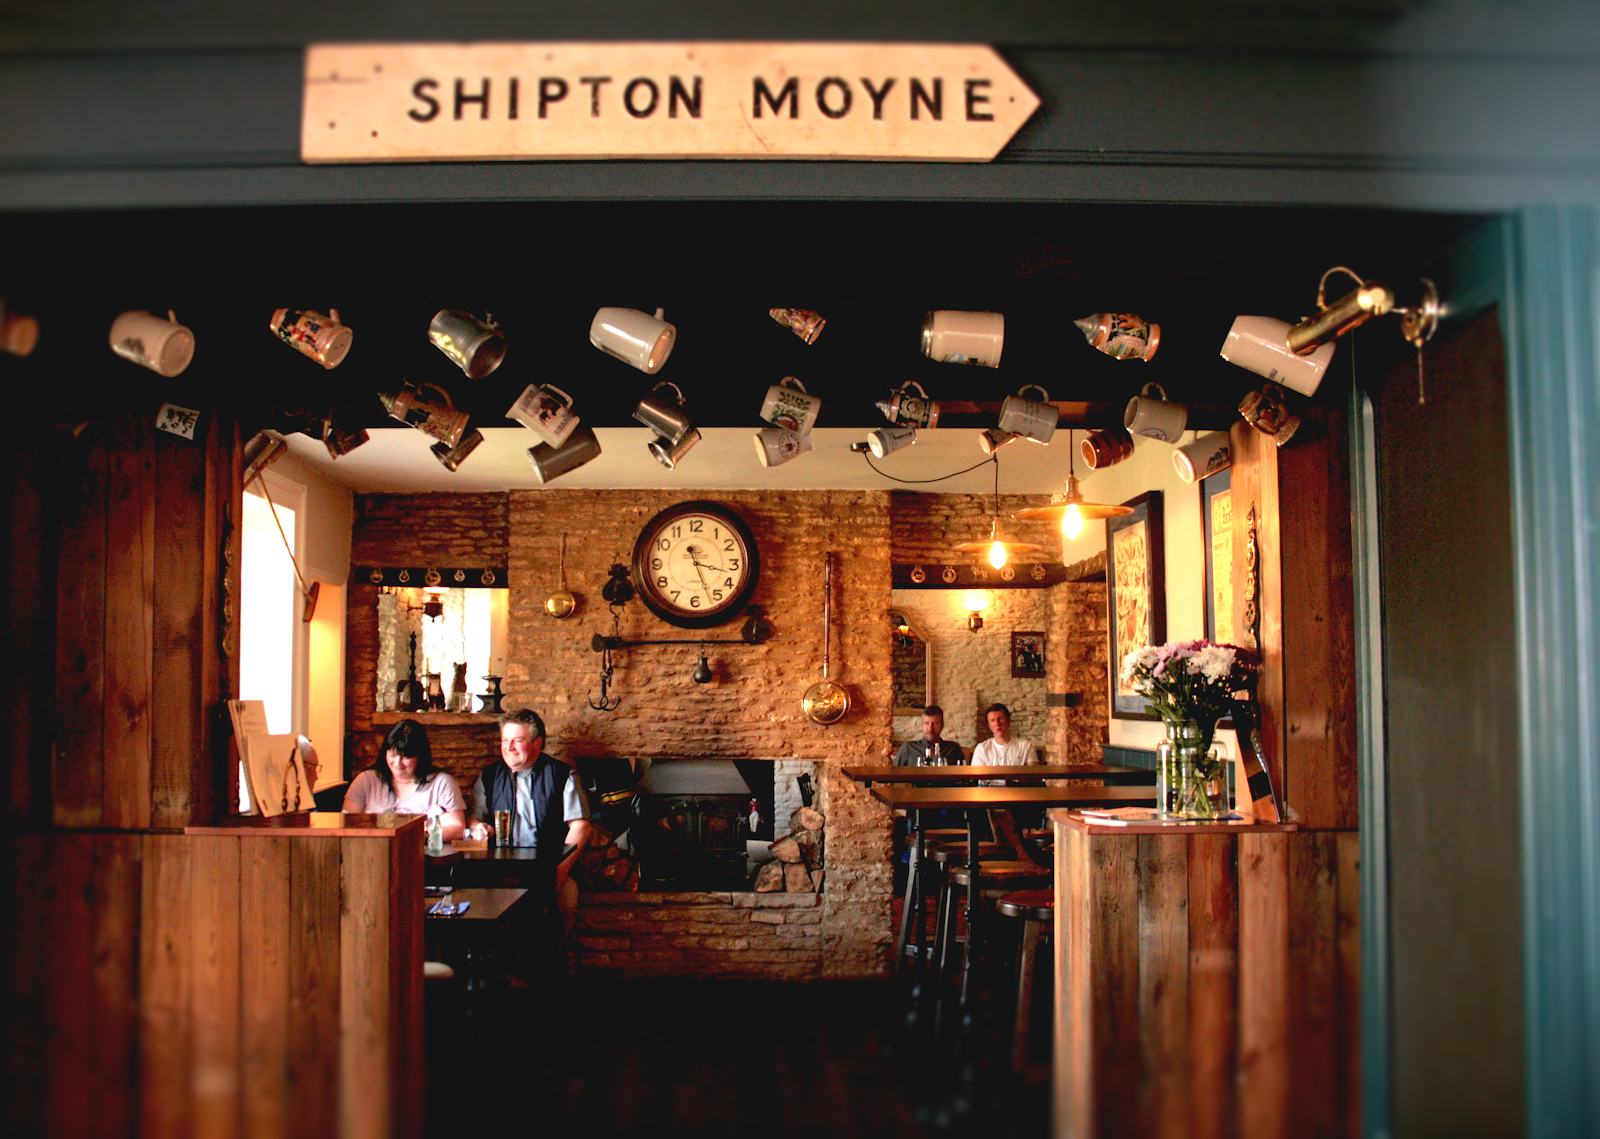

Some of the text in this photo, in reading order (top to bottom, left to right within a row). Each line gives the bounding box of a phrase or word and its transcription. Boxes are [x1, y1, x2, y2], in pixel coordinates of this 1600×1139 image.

[407, 76, 995, 123] SHIPTON MOYNE
[671, 526, 681, 538] 11
[689, 520, 703, 532] 12
[714, 527, 719, 539] 1
[656, 538, 670, 551] 10
[723, 539, 735, 551] 2
[652, 558, 663, 570] 9
[728, 559, 739, 571] 3
[656, 576, 668, 588] 8
[723, 577, 734, 589] 4
[670, 590, 681, 602] 7
[712, 589, 723, 601] 5
[690, 596, 701, 608] 6
